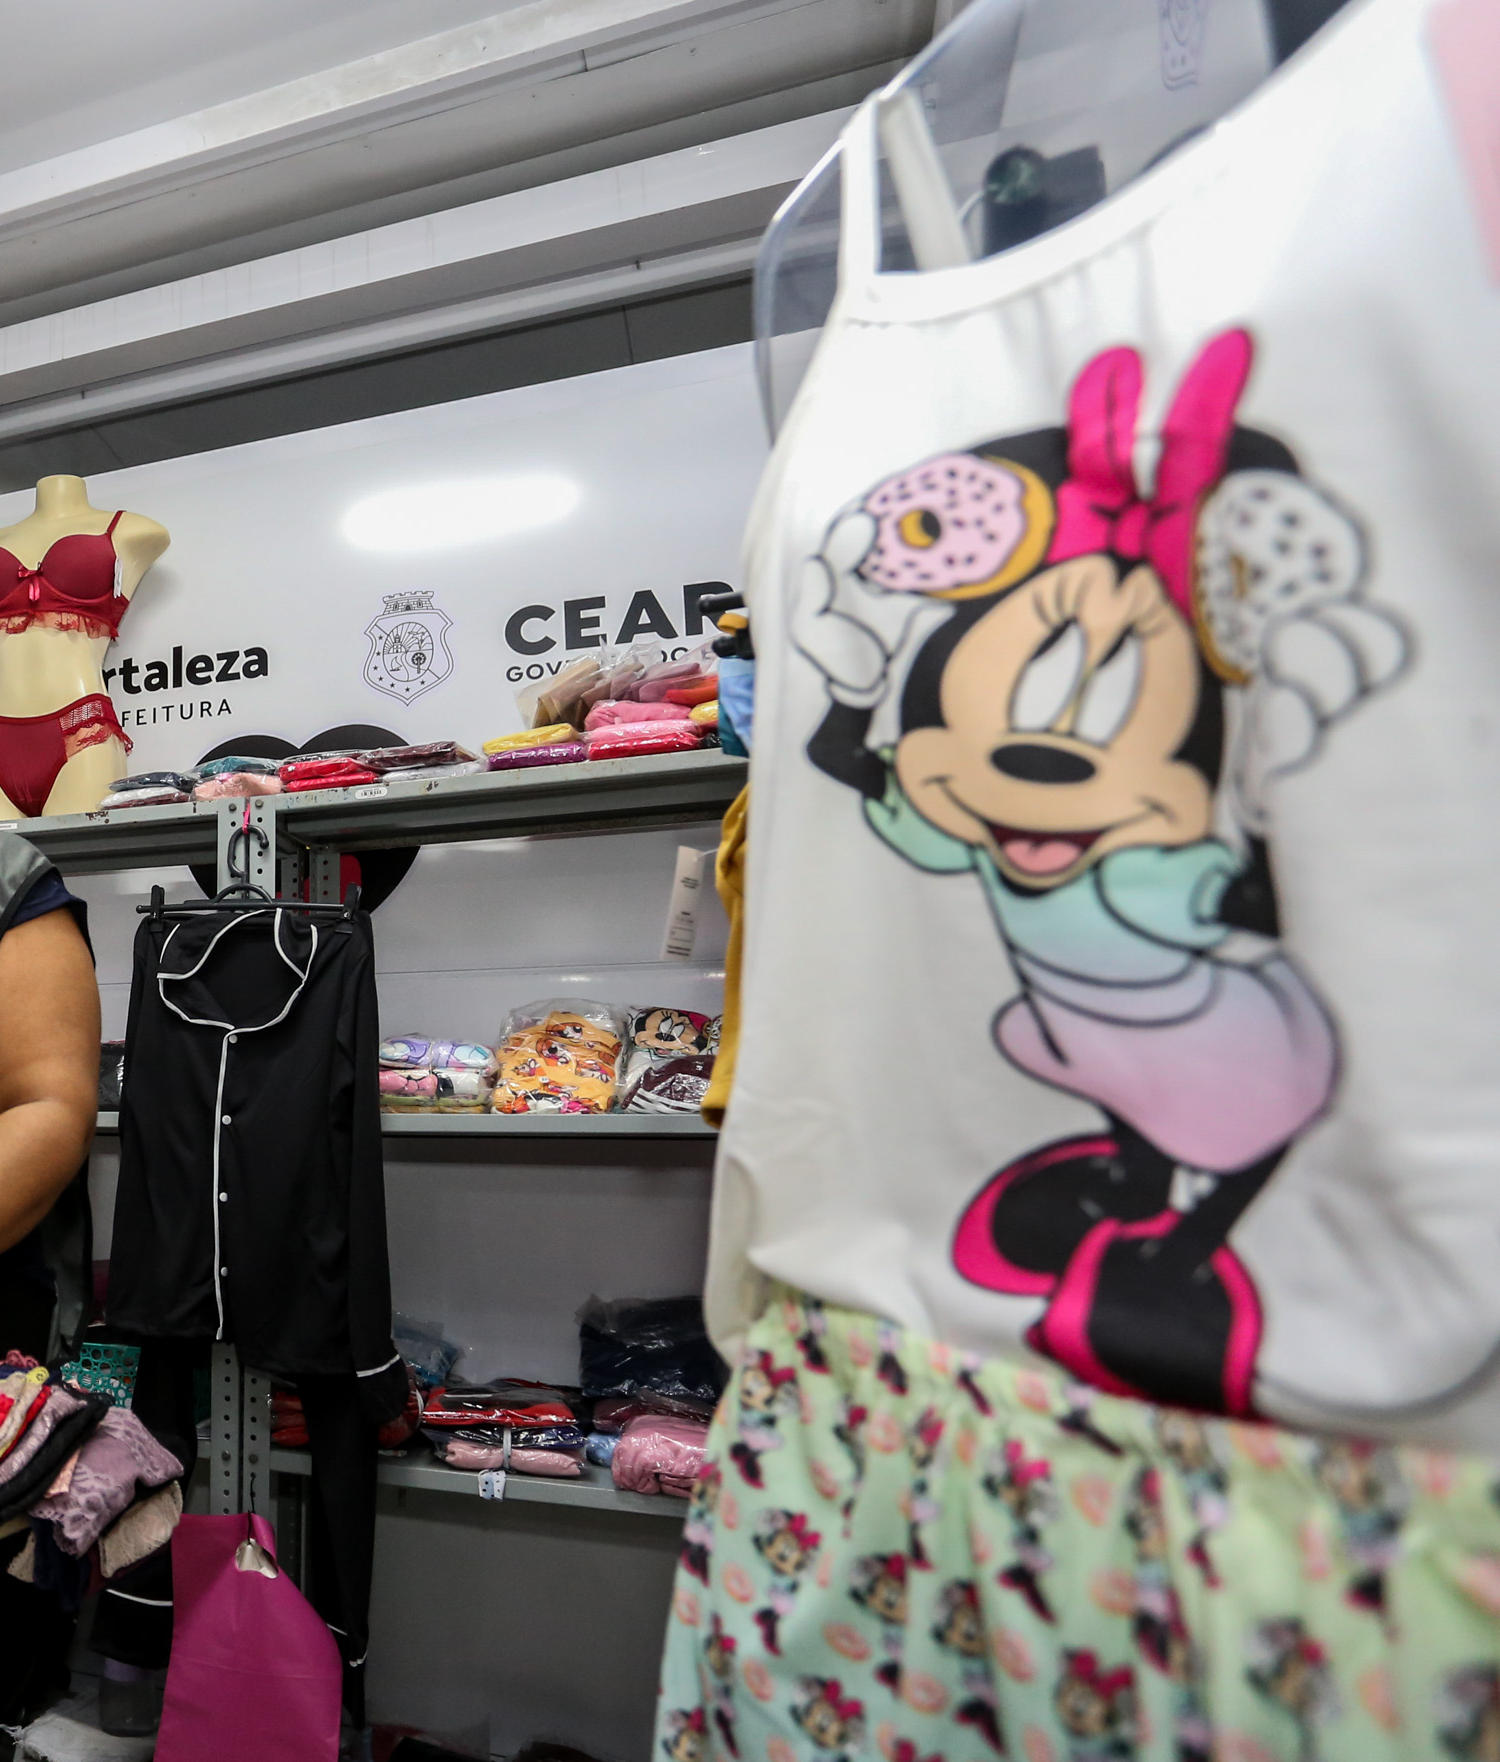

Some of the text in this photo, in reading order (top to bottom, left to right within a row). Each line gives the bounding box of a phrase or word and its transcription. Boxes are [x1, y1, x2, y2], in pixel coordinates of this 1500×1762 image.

[504, 580, 736, 656] CEAR
[102, 645, 269, 695] rtaleza
[121, 698, 232, 728] FEITURA
